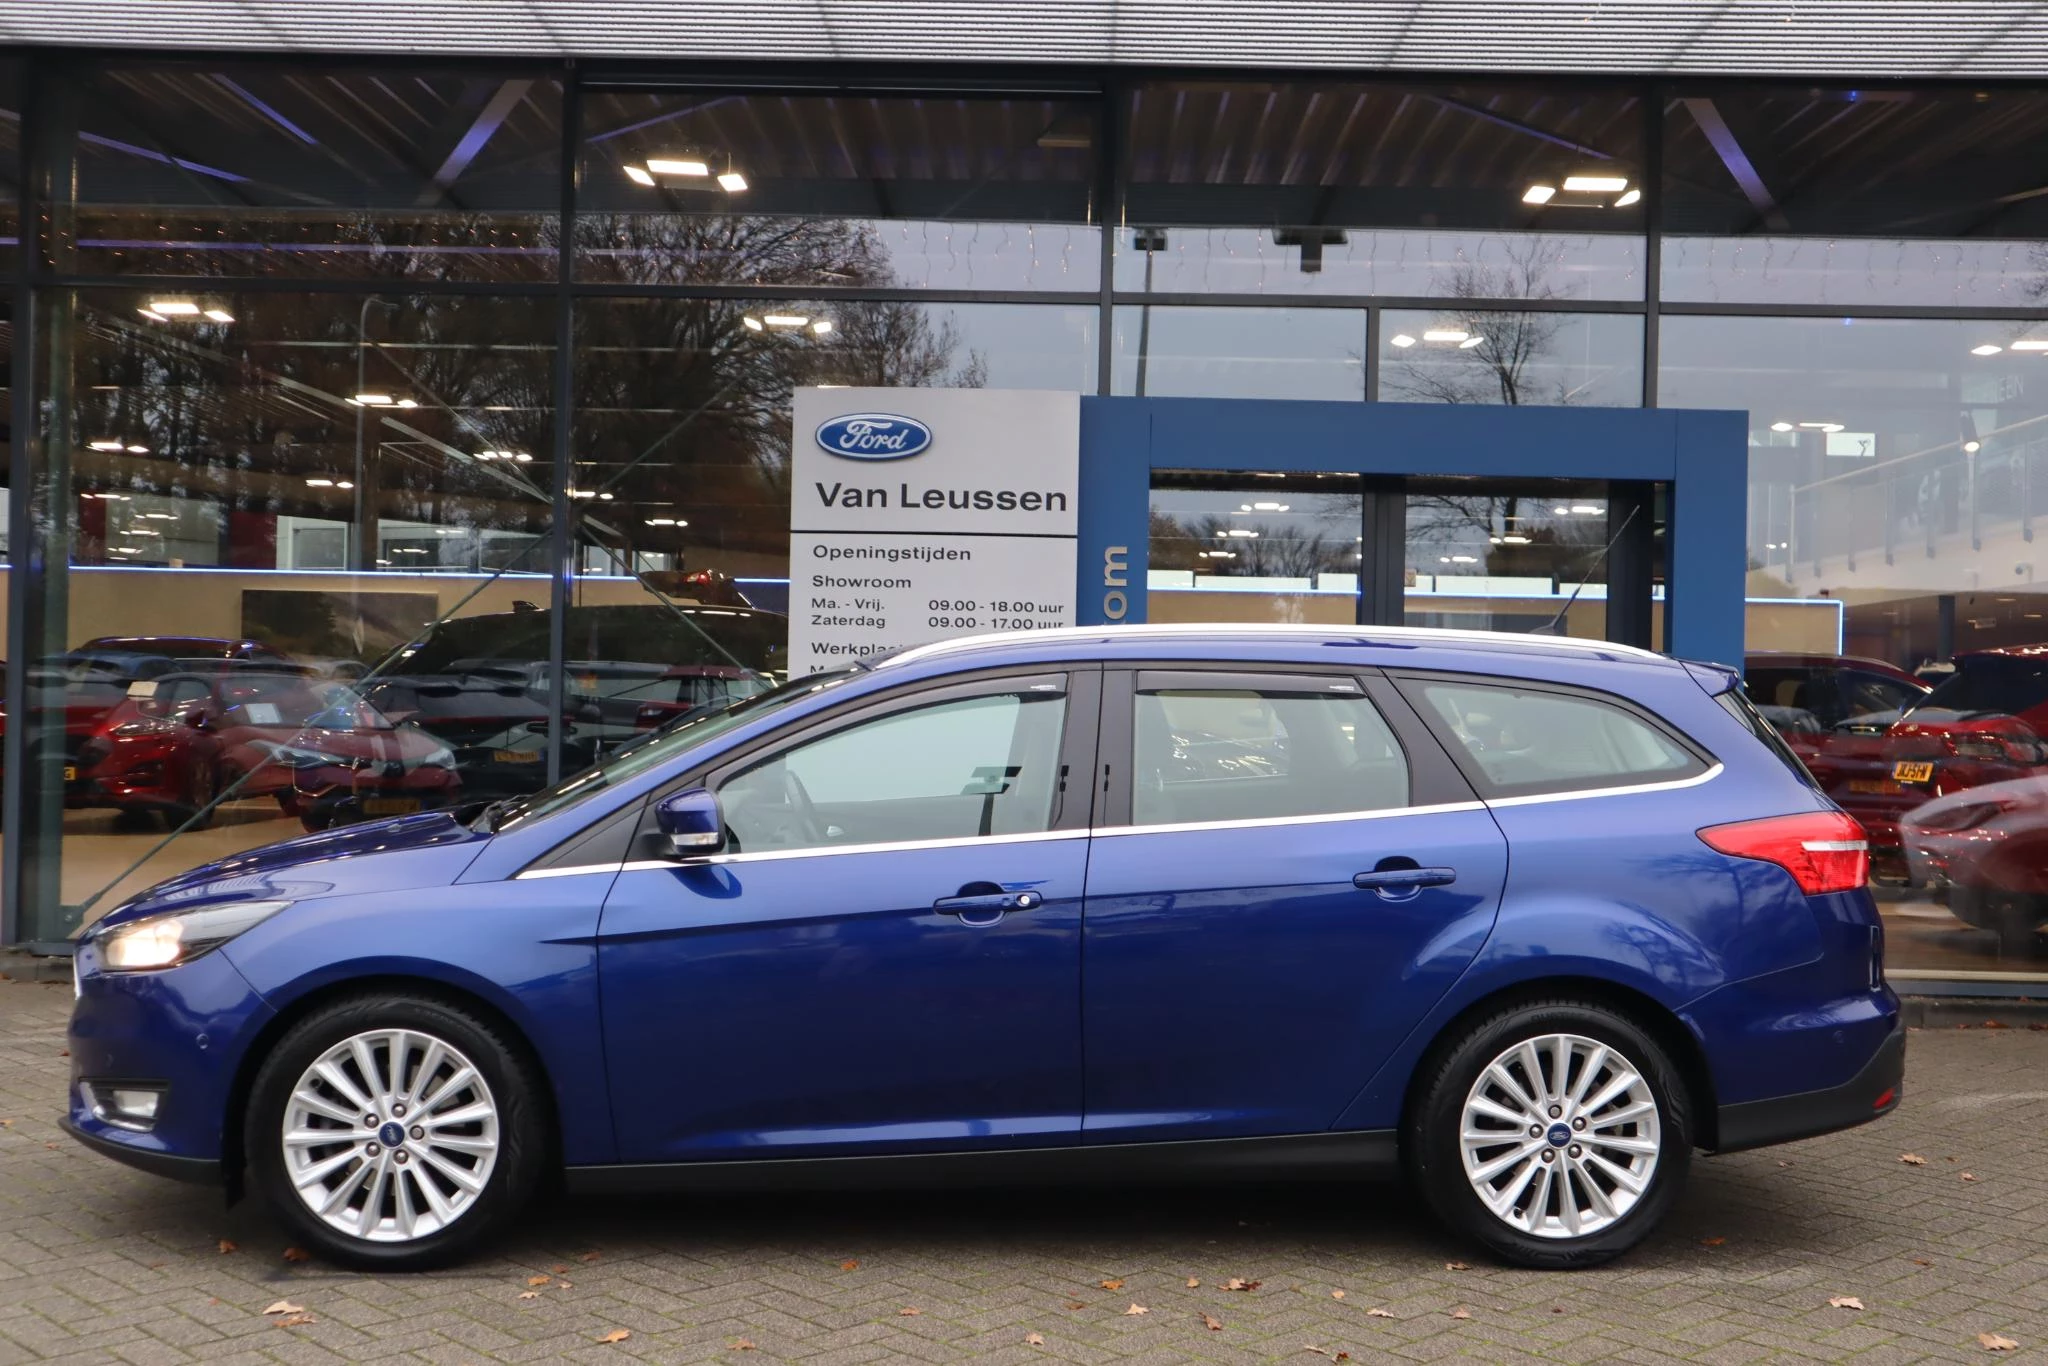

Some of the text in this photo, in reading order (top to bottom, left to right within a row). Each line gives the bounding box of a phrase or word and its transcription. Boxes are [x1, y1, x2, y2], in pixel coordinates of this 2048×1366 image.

[839, 420, 909, 449] Ford
[815, 482, 1068, 512] Van Leussen
[812, 544, 972, 563] Openingstijden
[812, 574, 912, 589] Showroom
[1103, 546, 1128, 625] om
[811, 597, 841, 609] Ma.
[854, 598, 886, 612] Vrij.
[928, 599, 976, 612] 09.00
[989, 600, 1035, 613] 18.00
[1038, 603, 1065, 614] uur
[811, 614, 886, 629] Zaterdag
[928, 616, 976, 629] 09.00
[991, 617, 1034, 630] 17.00
[1037, 620, 1064, 629] uur
